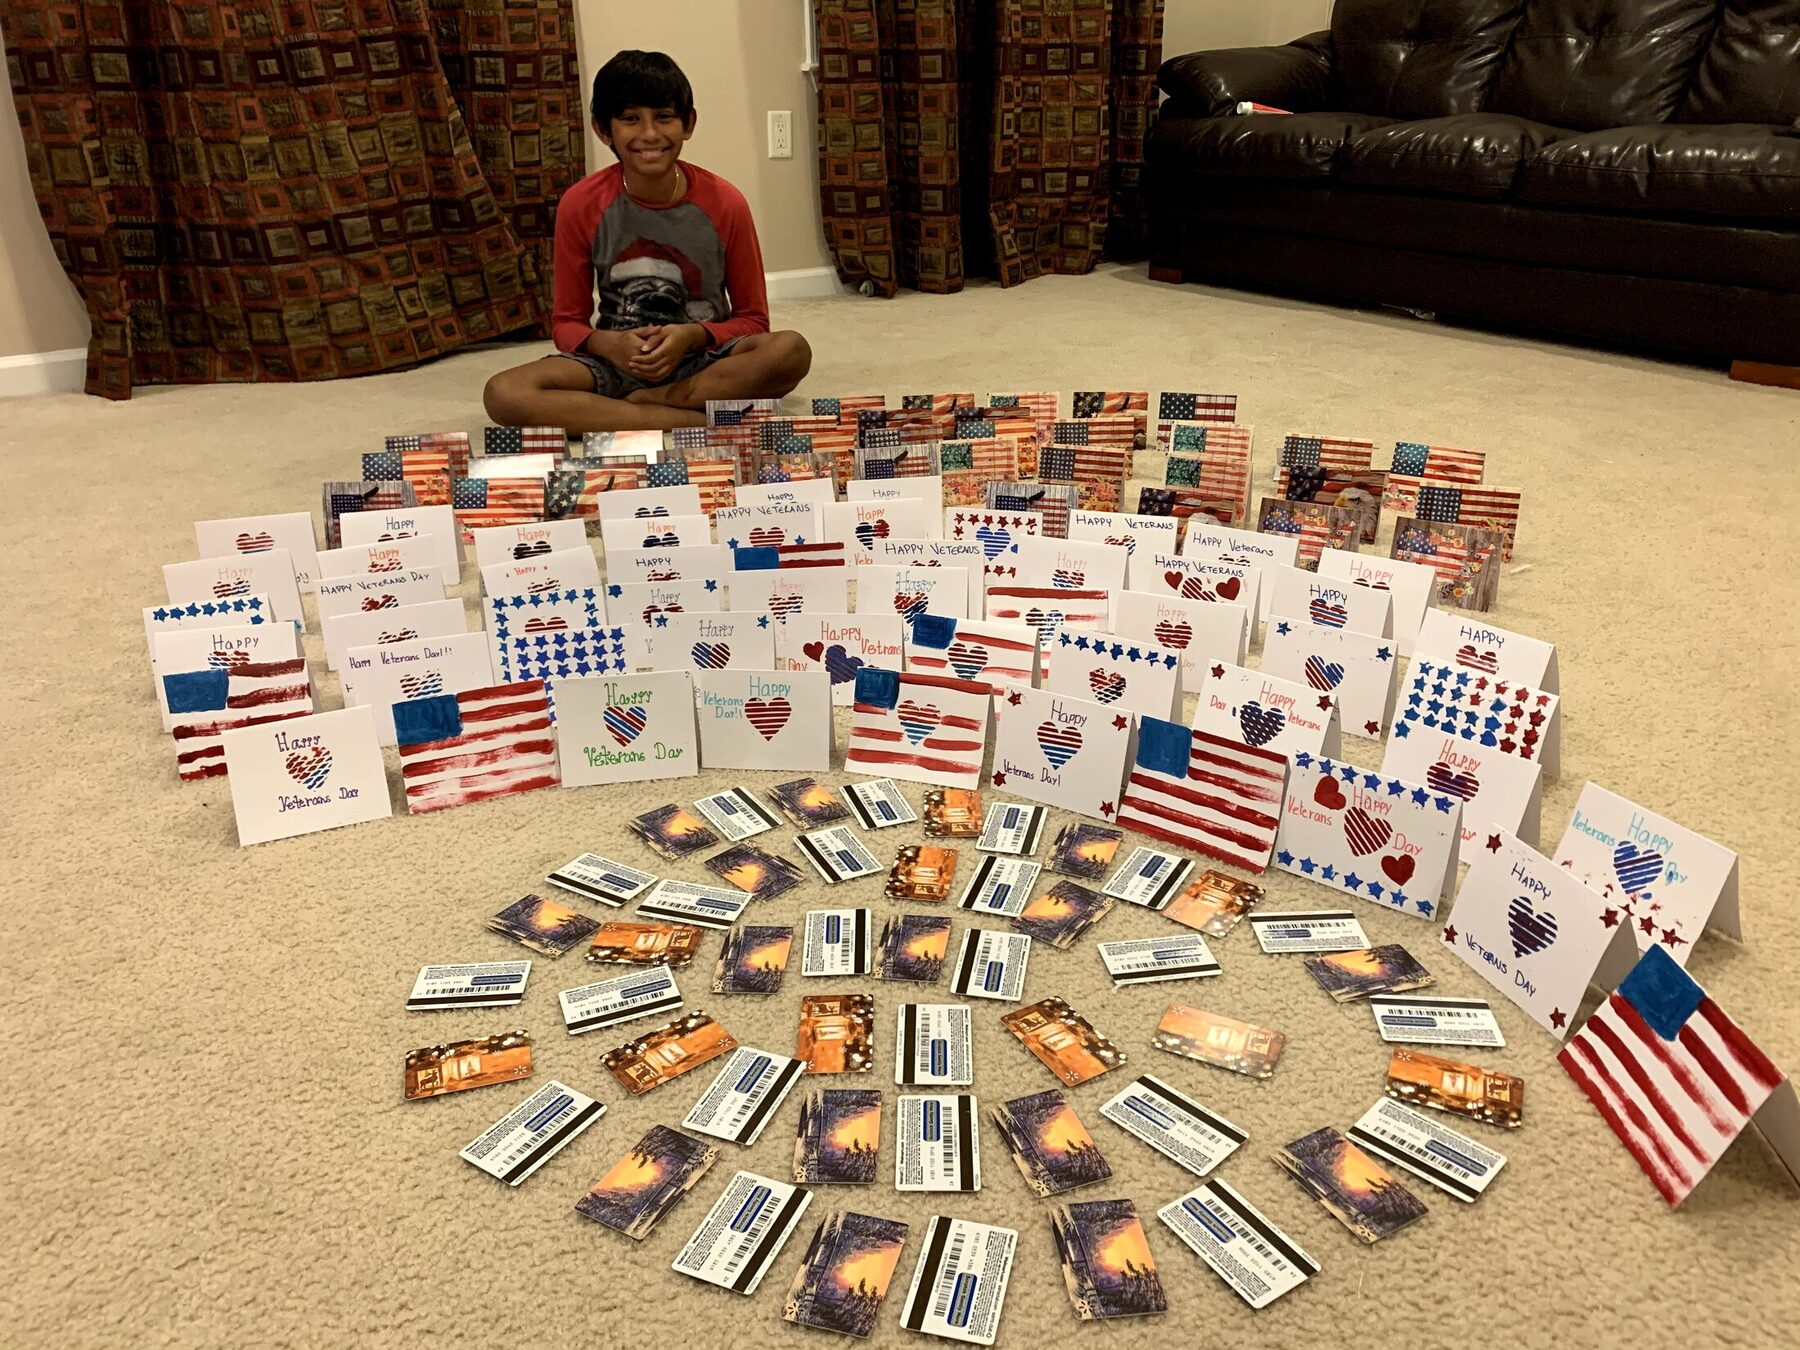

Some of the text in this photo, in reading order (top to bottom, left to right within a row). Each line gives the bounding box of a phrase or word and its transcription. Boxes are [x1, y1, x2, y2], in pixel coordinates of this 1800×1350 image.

[717, 502, 811, 520] HAPPY VETERANS
[856, 506, 885, 522] Happy
[386, 516, 414, 531] Happy
[647, 521, 676, 533] Happy
[1076, 514, 1174, 530] HAPPY VETERANS
[517, 527, 551, 542] Happy
[368, 547, 399, 561] Happy
[885, 543, 980, 555] HAPPY VETERANS
[1228, 538, 1274, 557] Veterans
[636, 557, 672, 568] HAPPY
[1057, 552, 1088, 571] Happy
[1155, 555, 1245, 577] HAPPY VETERANS
[1350, 560, 1395, 583] Happy
[320, 571, 430, 595] HAPPY VETERANS DAY
[1309, 584, 1348, 602] HAPPY
[650, 588, 681, 604] Happy
[1157, 604, 1187, 620] Happy
[699, 619, 734, 638] Happy
[821, 621, 862, 641] Happy
[1460, 625, 1506, 648] HAPPY
[212, 634, 259, 650] Happy
[380, 652, 420, 666] Veterans
[750, 675, 791, 697] Happy
[1260, 680, 1297, 710] Happy
[703, 691, 744, 706] Veterans
[1210, 694, 1227, 711] Day
[1050, 700, 1088, 727] Happy
[275, 731, 321, 752] Happy
[583, 741, 684, 767] Veterans Day
[1439, 739, 1481, 772] Happy
[1003, 759, 1035, 781] Veterans
[278, 787, 360, 813] Veterans Day
[1288, 794, 1333, 826] Veterans
[1353, 785, 1393, 816] Happy
[1572, 809, 1617, 847] Veterans
[1627, 811, 1674, 855] Happy
[1392, 832, 1424, 856] Day
[1511, 862, 1552, 901] HAPPY
[1514, 969, 1537, 997] DAY
